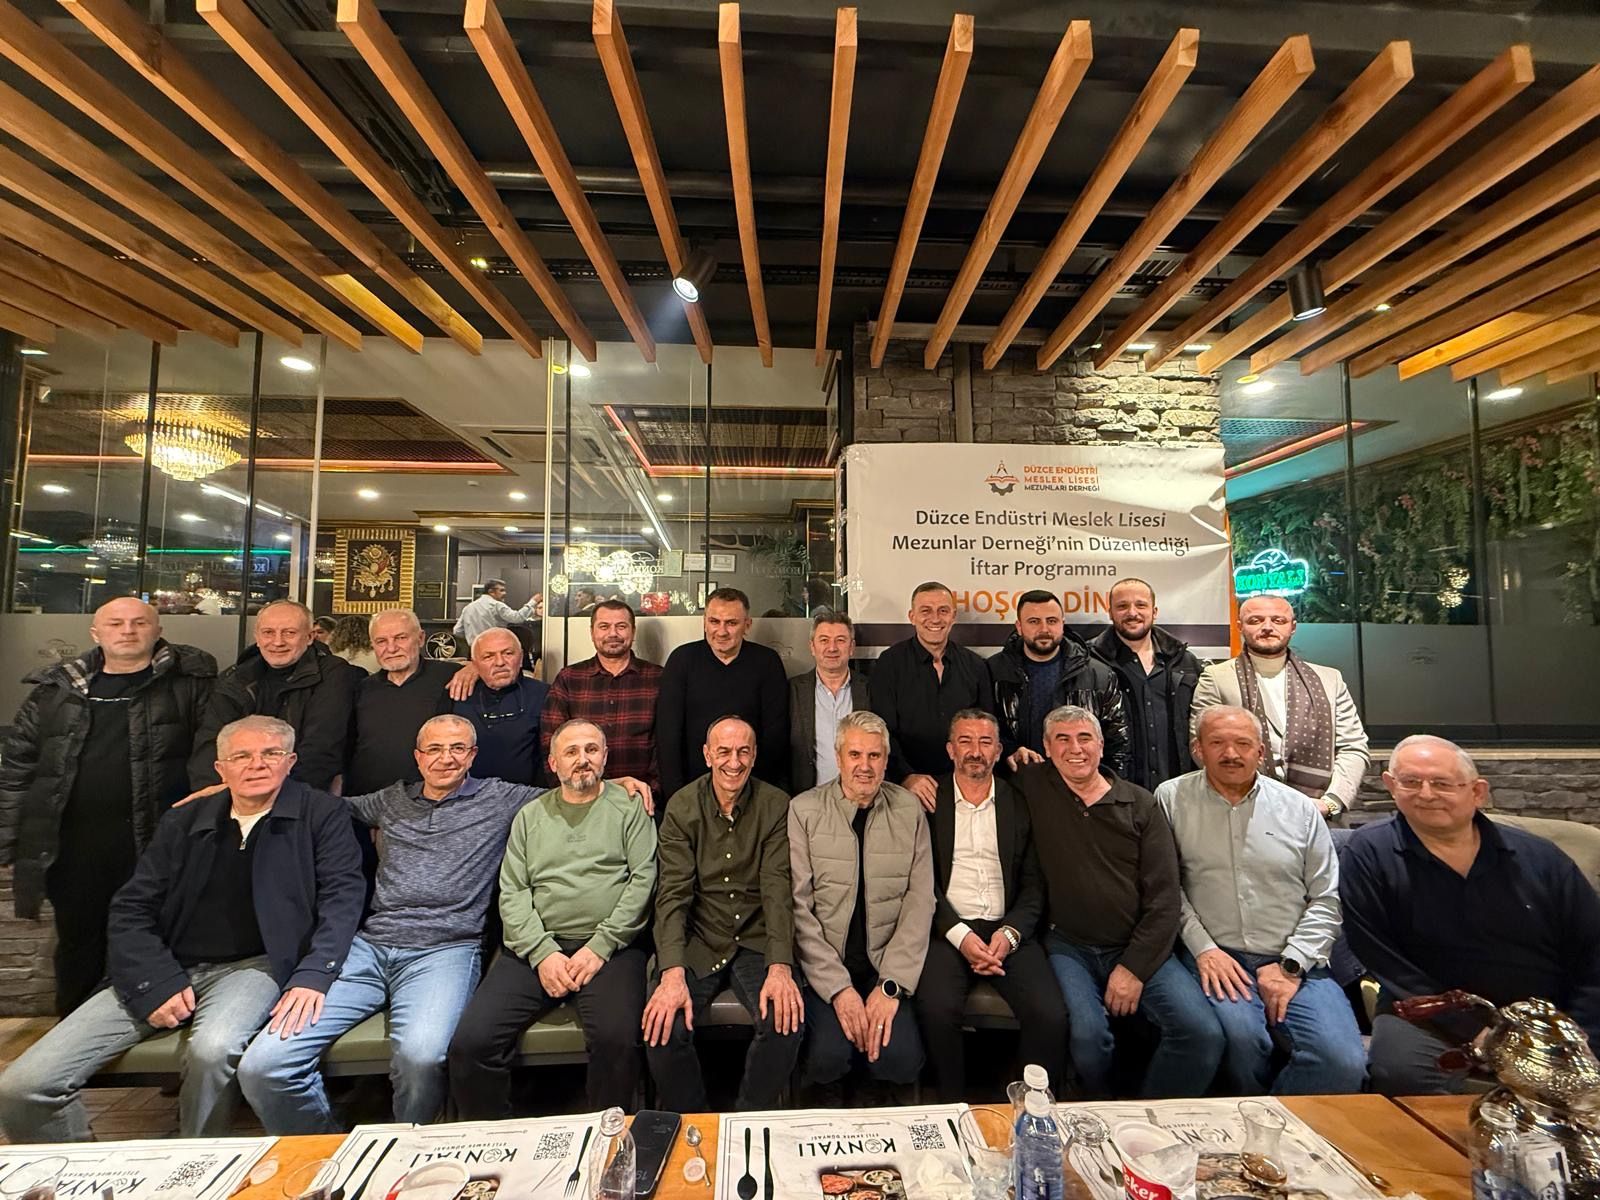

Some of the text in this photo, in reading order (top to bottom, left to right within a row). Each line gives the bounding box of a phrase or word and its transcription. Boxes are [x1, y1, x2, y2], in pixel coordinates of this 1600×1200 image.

[1023, 464, 1098, 475] DÜZCE ENDÜSTRİ
[1024, 475, 1099, 484] MESLEK LİSESİ
[916, 509, 1167, 527] Düzce Endüstri Meslek Lisesi
[892, 534, 1190, 557] Mezunlar Derneği’nin Düzenlediği
[970, 557, 1117, 581] İftar Programına
[798, 1138, 897, 1157] KONYALI
